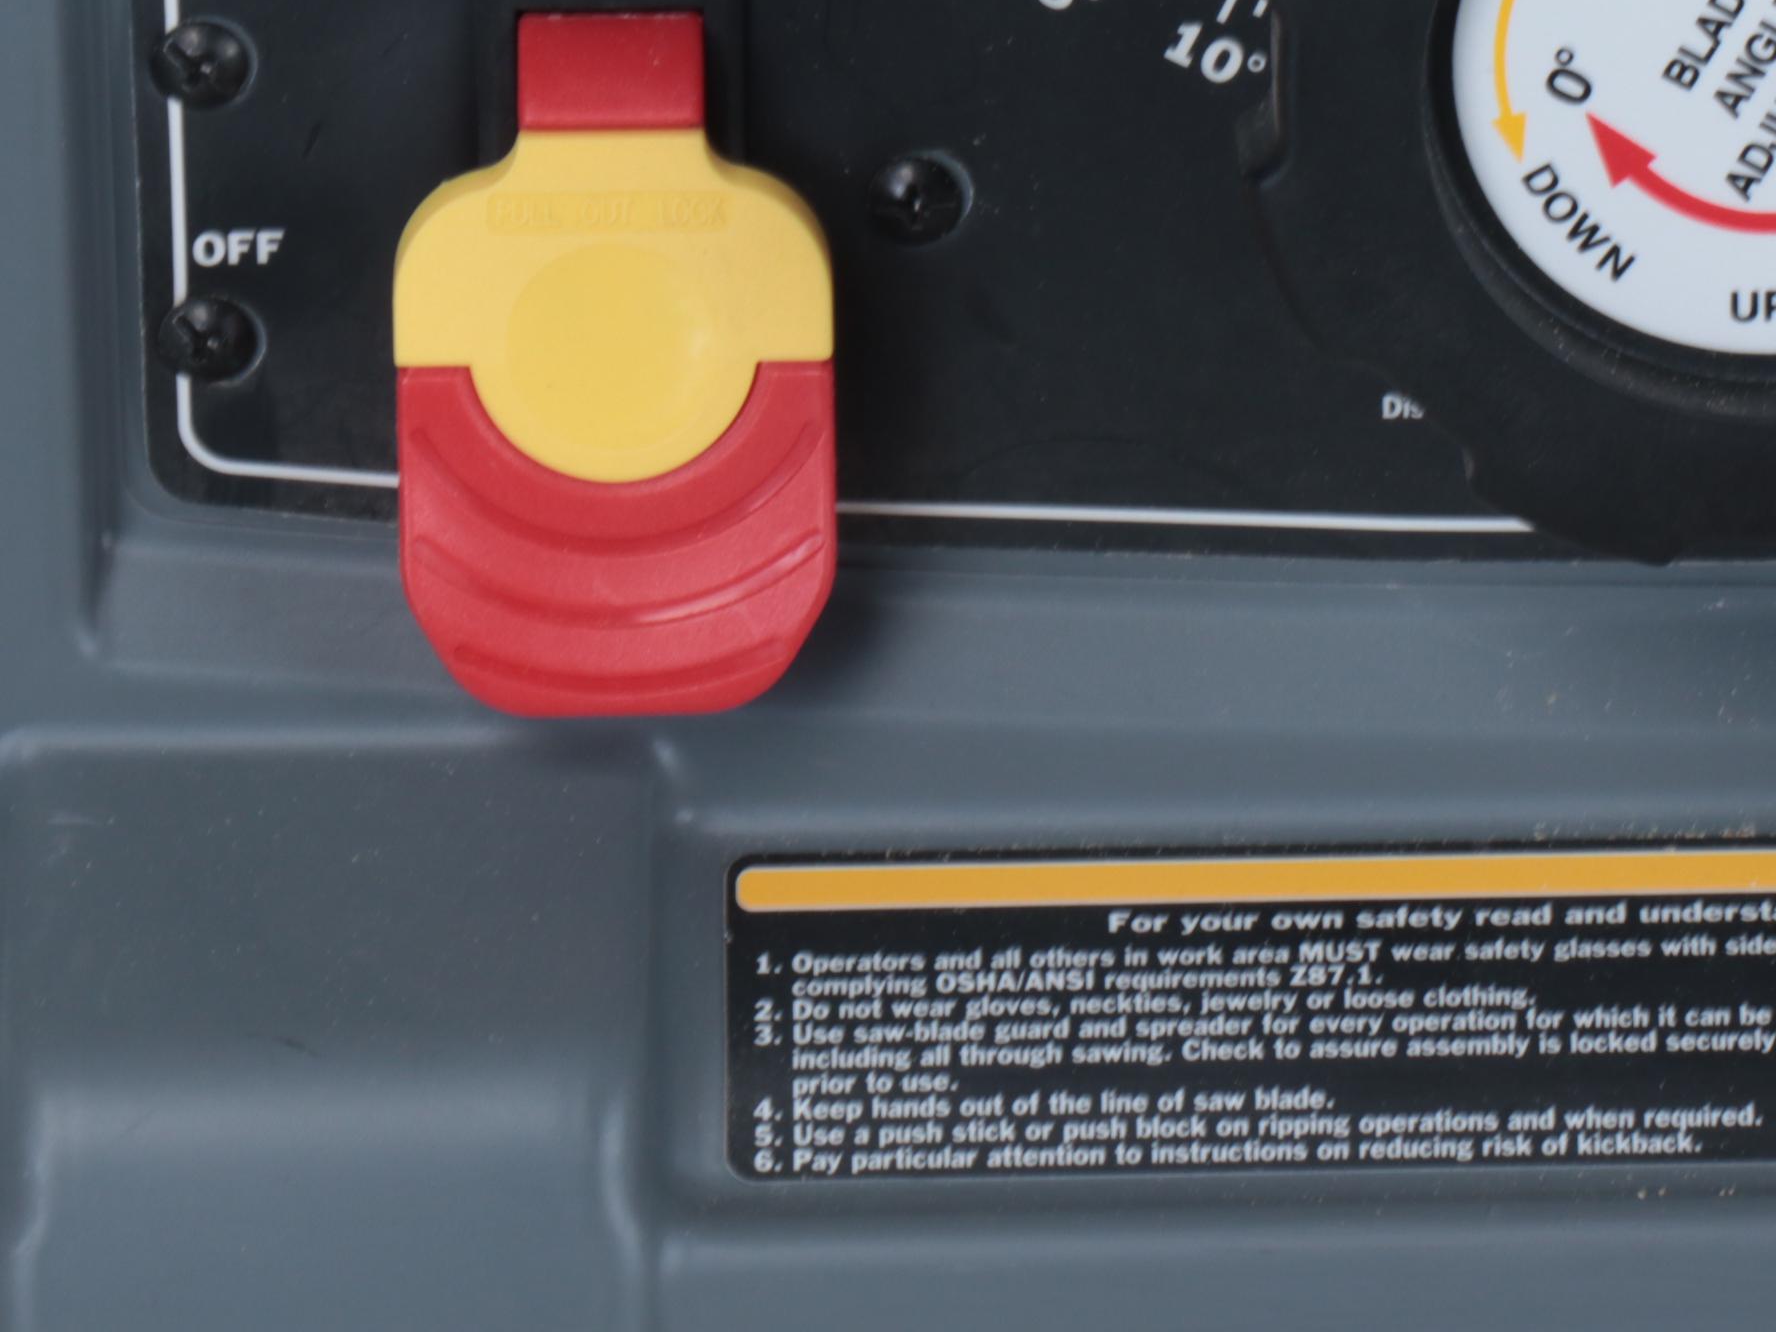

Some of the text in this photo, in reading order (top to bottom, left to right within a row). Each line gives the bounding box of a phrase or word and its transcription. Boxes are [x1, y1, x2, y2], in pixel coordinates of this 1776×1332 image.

[1521, 163, 1638, 282] DOWN
[193, 231, 283, 266] OFF
[1107, 914, 1169, 933] For
[1180, 916, 1259, 935] your
[1270, 915, 1344, 930] own
[1356, 908, 1463, 932] safety
[1475, 907, 1553, 926] read
[1564, 906, 1628, 925] and
[791, 951, 927, 976] Operators
[933, 950, 983, 969] and
[989, 950, 1023, 968] all
[1028, 948, 1116, 968] others
[1123, 948, 1149, 966] in
[1156, 946, 1224, 965] work
[1231, 949, 1291, 964] area
[1298, 944, 1381, 963] MUST
[1390, 946, 1456, 962] wear
[1464, 941, 1546, 964] safety
[1553, 939, 1653, 963] glasses
[1660, 938, 1718, 957] with
[792, 1099, 864, 1123] Keep
[871, 1098, 952, 1117] hands
[958, 1097, 1005, 1116] out
[1011, 1097, 1041, 1115] of
[1047, 1096, 1093, 1115] the
[1100, 1095, 1150, 1114] line
[1156, 1095, 1186, 1113] of
[1193, 1098, 1246, 1112] saw
